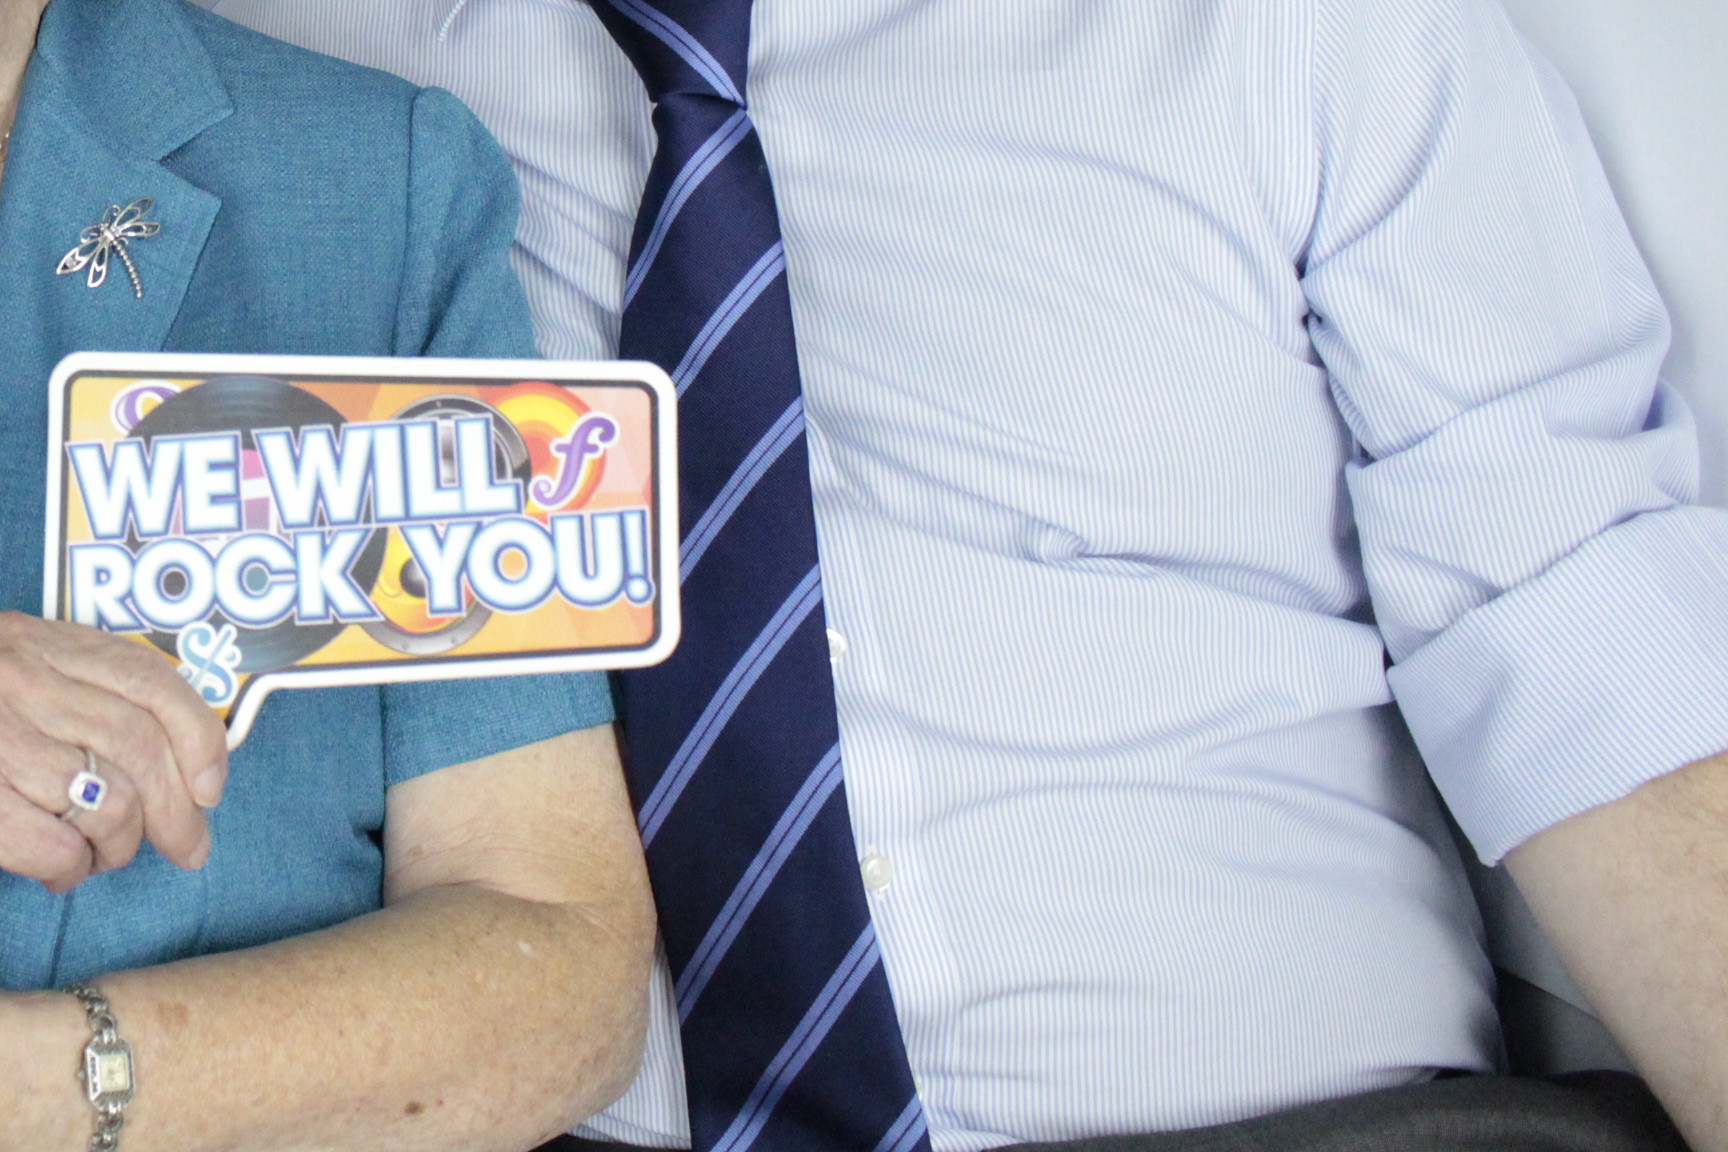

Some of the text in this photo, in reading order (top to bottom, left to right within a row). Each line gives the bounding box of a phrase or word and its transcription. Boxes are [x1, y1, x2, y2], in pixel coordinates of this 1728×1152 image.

[68, 415, 524, 540] WE WILL
[68, 509, 654, 633] ROCK YOU!
